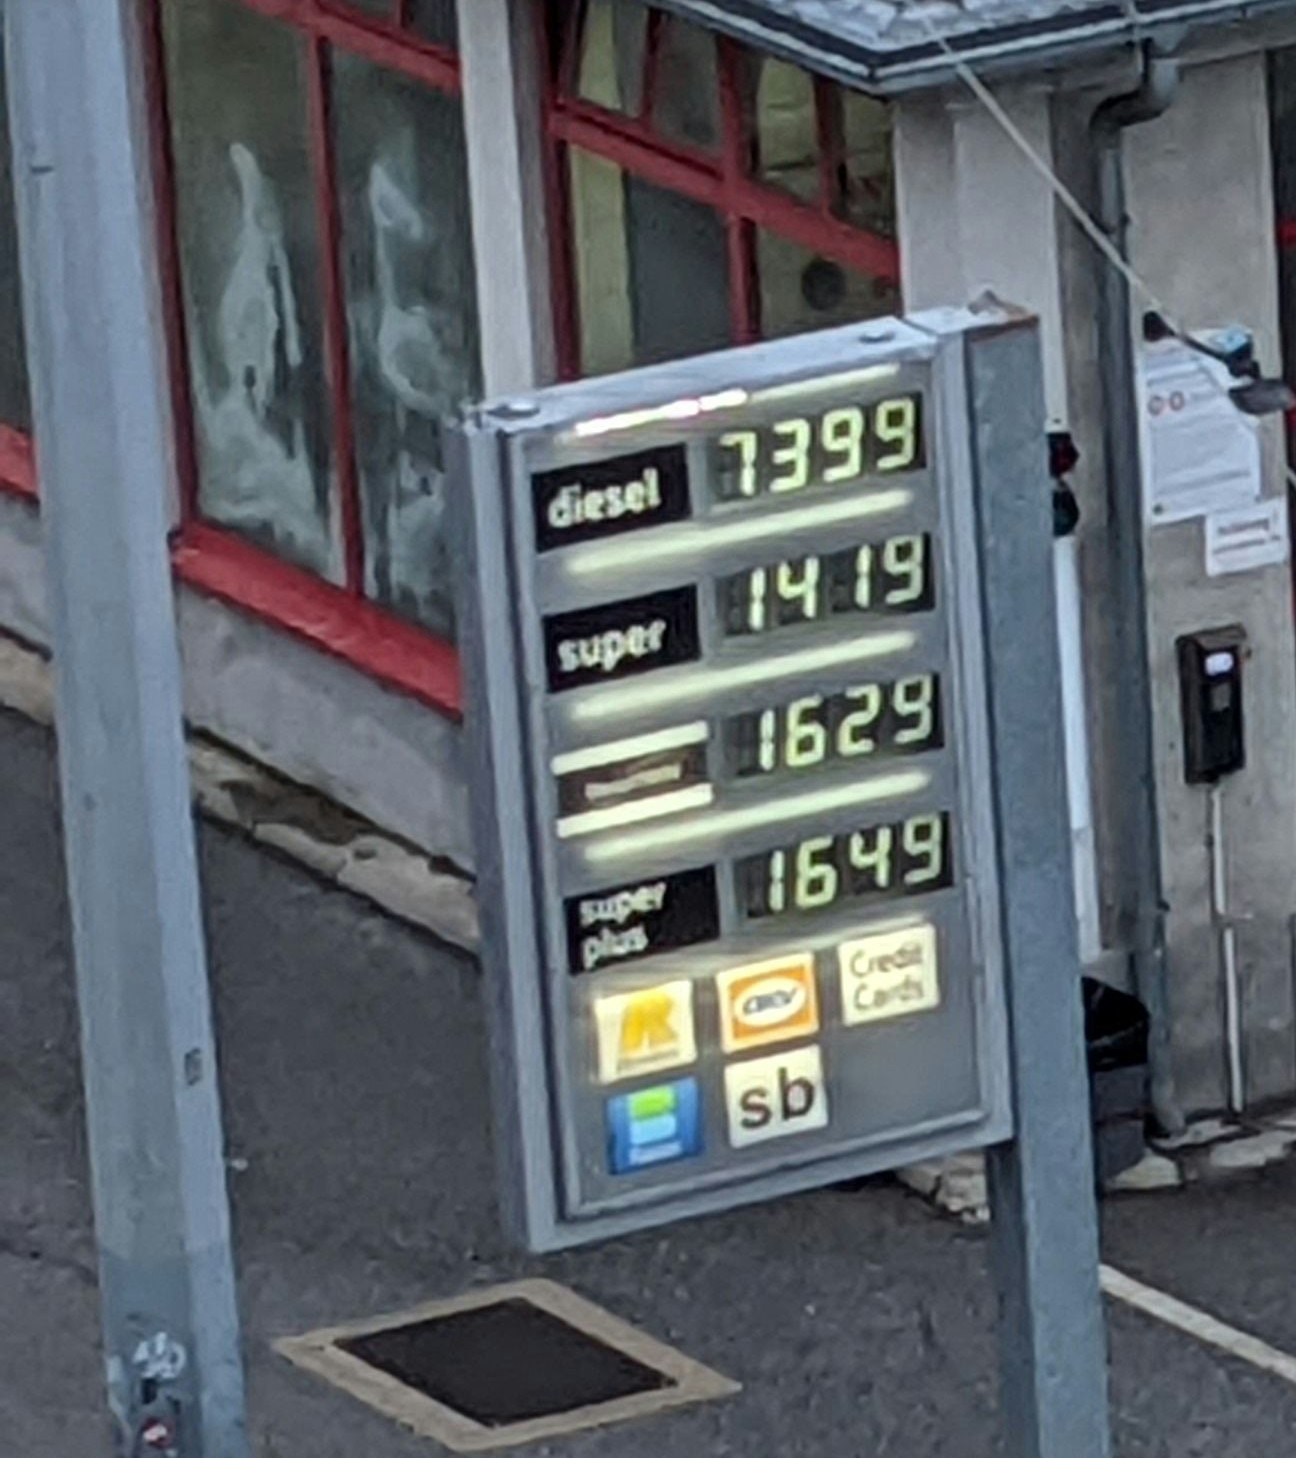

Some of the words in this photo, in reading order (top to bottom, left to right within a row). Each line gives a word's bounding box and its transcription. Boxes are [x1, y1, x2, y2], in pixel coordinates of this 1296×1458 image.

[718, 396, 916, 497] 7399
[547, 466, 661, 528] diesel
[747, 533, 924, 632] 1419
[557, 619, 667, 672] super
[758, 672, 933, 771] 1629
[768, 812, 942, 912] 1649
[579, 881, 667, 927] super
[582, 922, 649, 971] plus
[850, 941, 923, 977] Credit
[740, 1067, 815, 1130] sb
